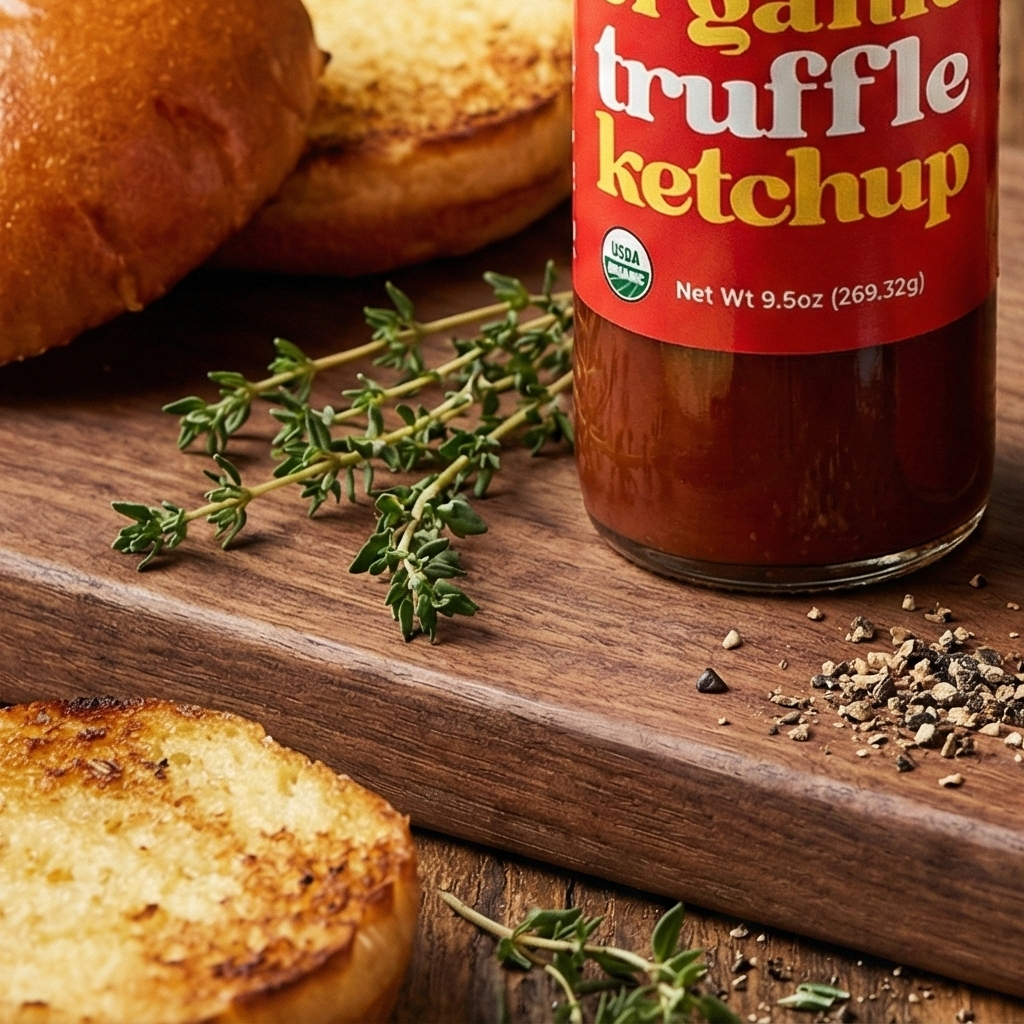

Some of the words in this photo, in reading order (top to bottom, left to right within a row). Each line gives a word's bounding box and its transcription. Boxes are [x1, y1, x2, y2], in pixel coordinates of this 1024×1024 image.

[594, 25, 970, 139] truffle
[595, 111, 970, 229] ketchup
[611, 240, 640, 266] USDA
[676, 280, 714, 305] Net
[720, 287, 755, 308] Wt
[761, 290, 824, 309] 9.5oz
[831, 271, 925, 311] (269.32g)
